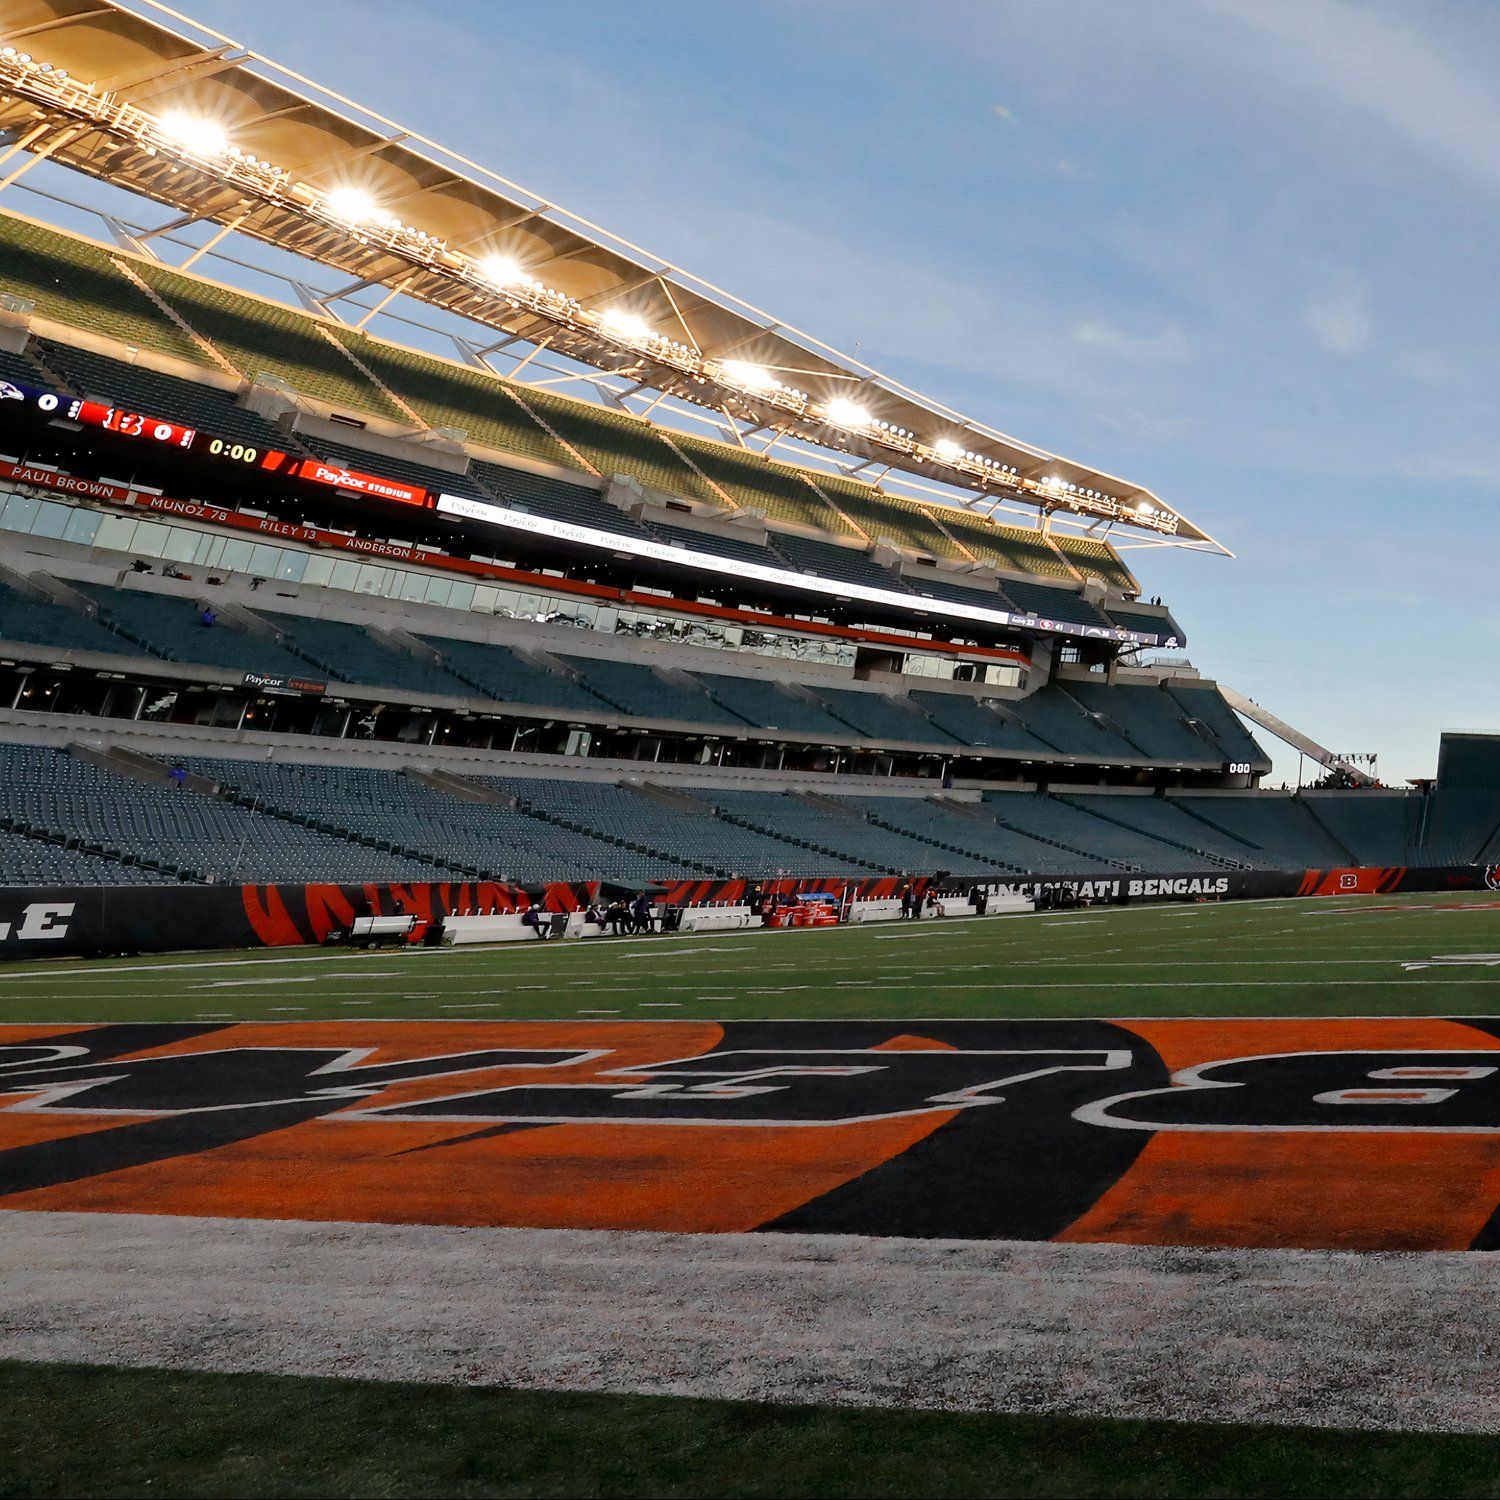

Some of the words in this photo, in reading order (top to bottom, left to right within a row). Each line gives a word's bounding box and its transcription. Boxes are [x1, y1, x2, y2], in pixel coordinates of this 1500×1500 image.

[38, 394, 58, 411] 0
[154, 424, 172, 441] 0
[209, 439, 257, 463] 0:00
[11, 467, 52, 485] PAUL
[56, 477, 114, 498] BROWN
[315, 466, 367, 490] Paycor
[367, 483, 413, 500] STADIUM
[211, 509, 227, 522] 78
[259, 520, 299, 537] RILEY
[303, 530, 317, 540] 13
[346, 539, 410, 558] ANDERSON
[414, 551, 426, 561] 71
[245, 673, 283, 687] Paycor
[1128, 878, 1229, 897] BENGALS
